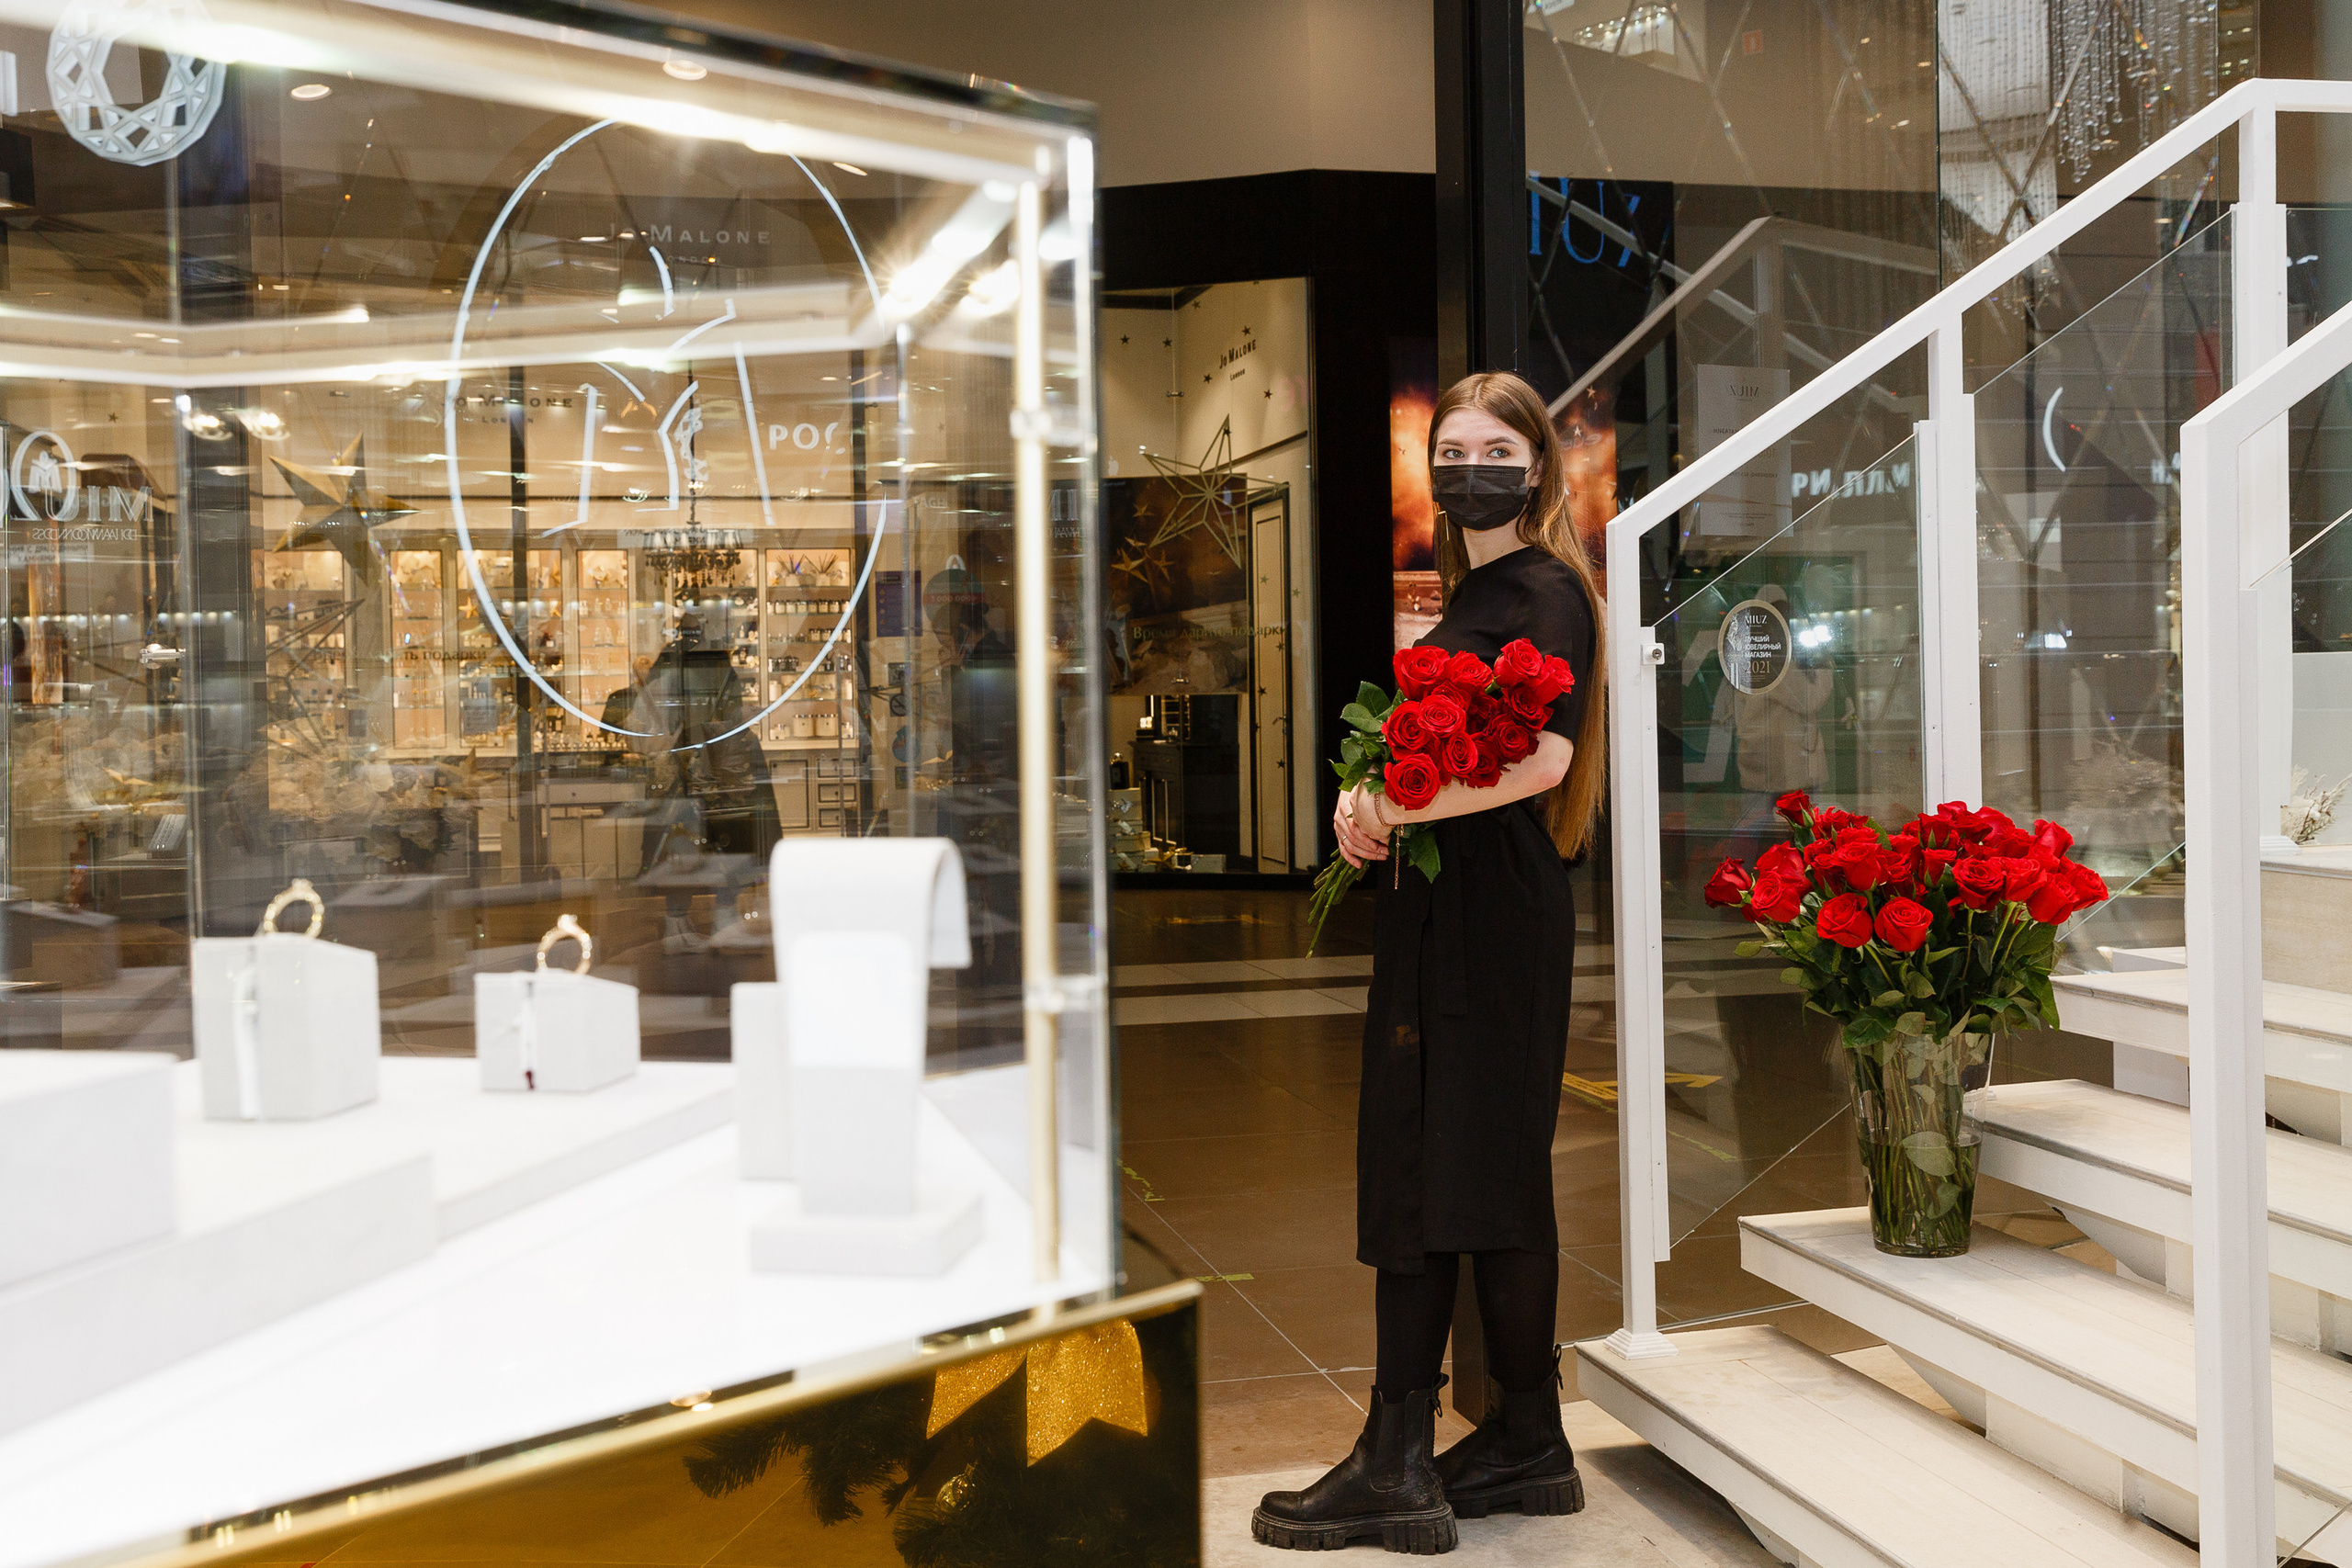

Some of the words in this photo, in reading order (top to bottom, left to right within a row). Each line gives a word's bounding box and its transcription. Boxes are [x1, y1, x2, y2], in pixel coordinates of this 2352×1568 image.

[650, 224, 770, 244] MALONE
[1228, 339, 1257, 364] MALONE
[1745, 615, 1768, 625] MIUZ
[1134, 626, 1177, 640] Время
[1745, 634, 1770, 642] ЛУЧШИЙ
[1744, 642, 1781, 650] ЮВЕЛИРНЫЙ
[1745, 660, 1771, 674] 2021
